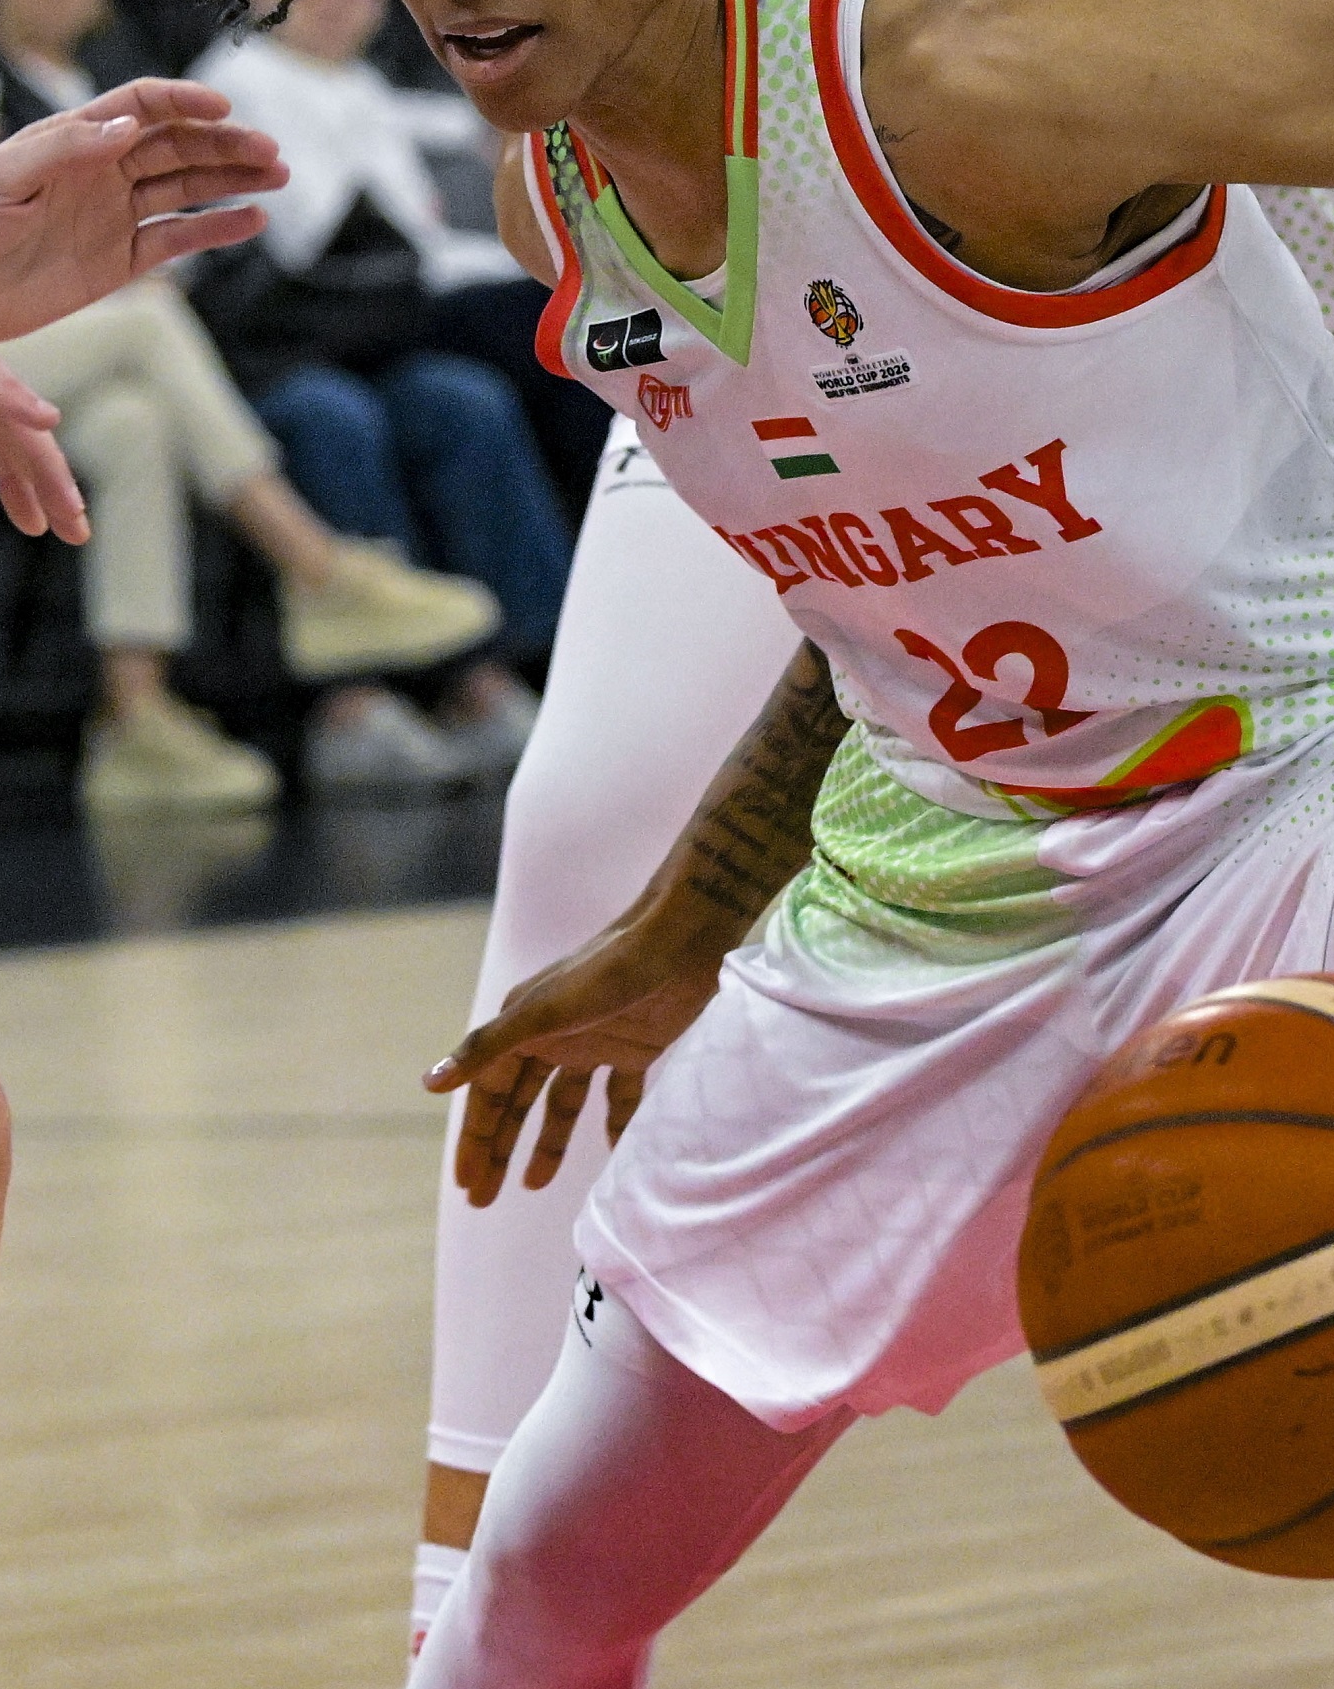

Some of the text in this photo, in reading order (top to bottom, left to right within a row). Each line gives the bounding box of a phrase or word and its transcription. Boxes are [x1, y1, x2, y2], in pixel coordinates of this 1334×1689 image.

[816, 361, 911, 390] WORLD CUP 2026
[893, 620, 1099, 762] 22
